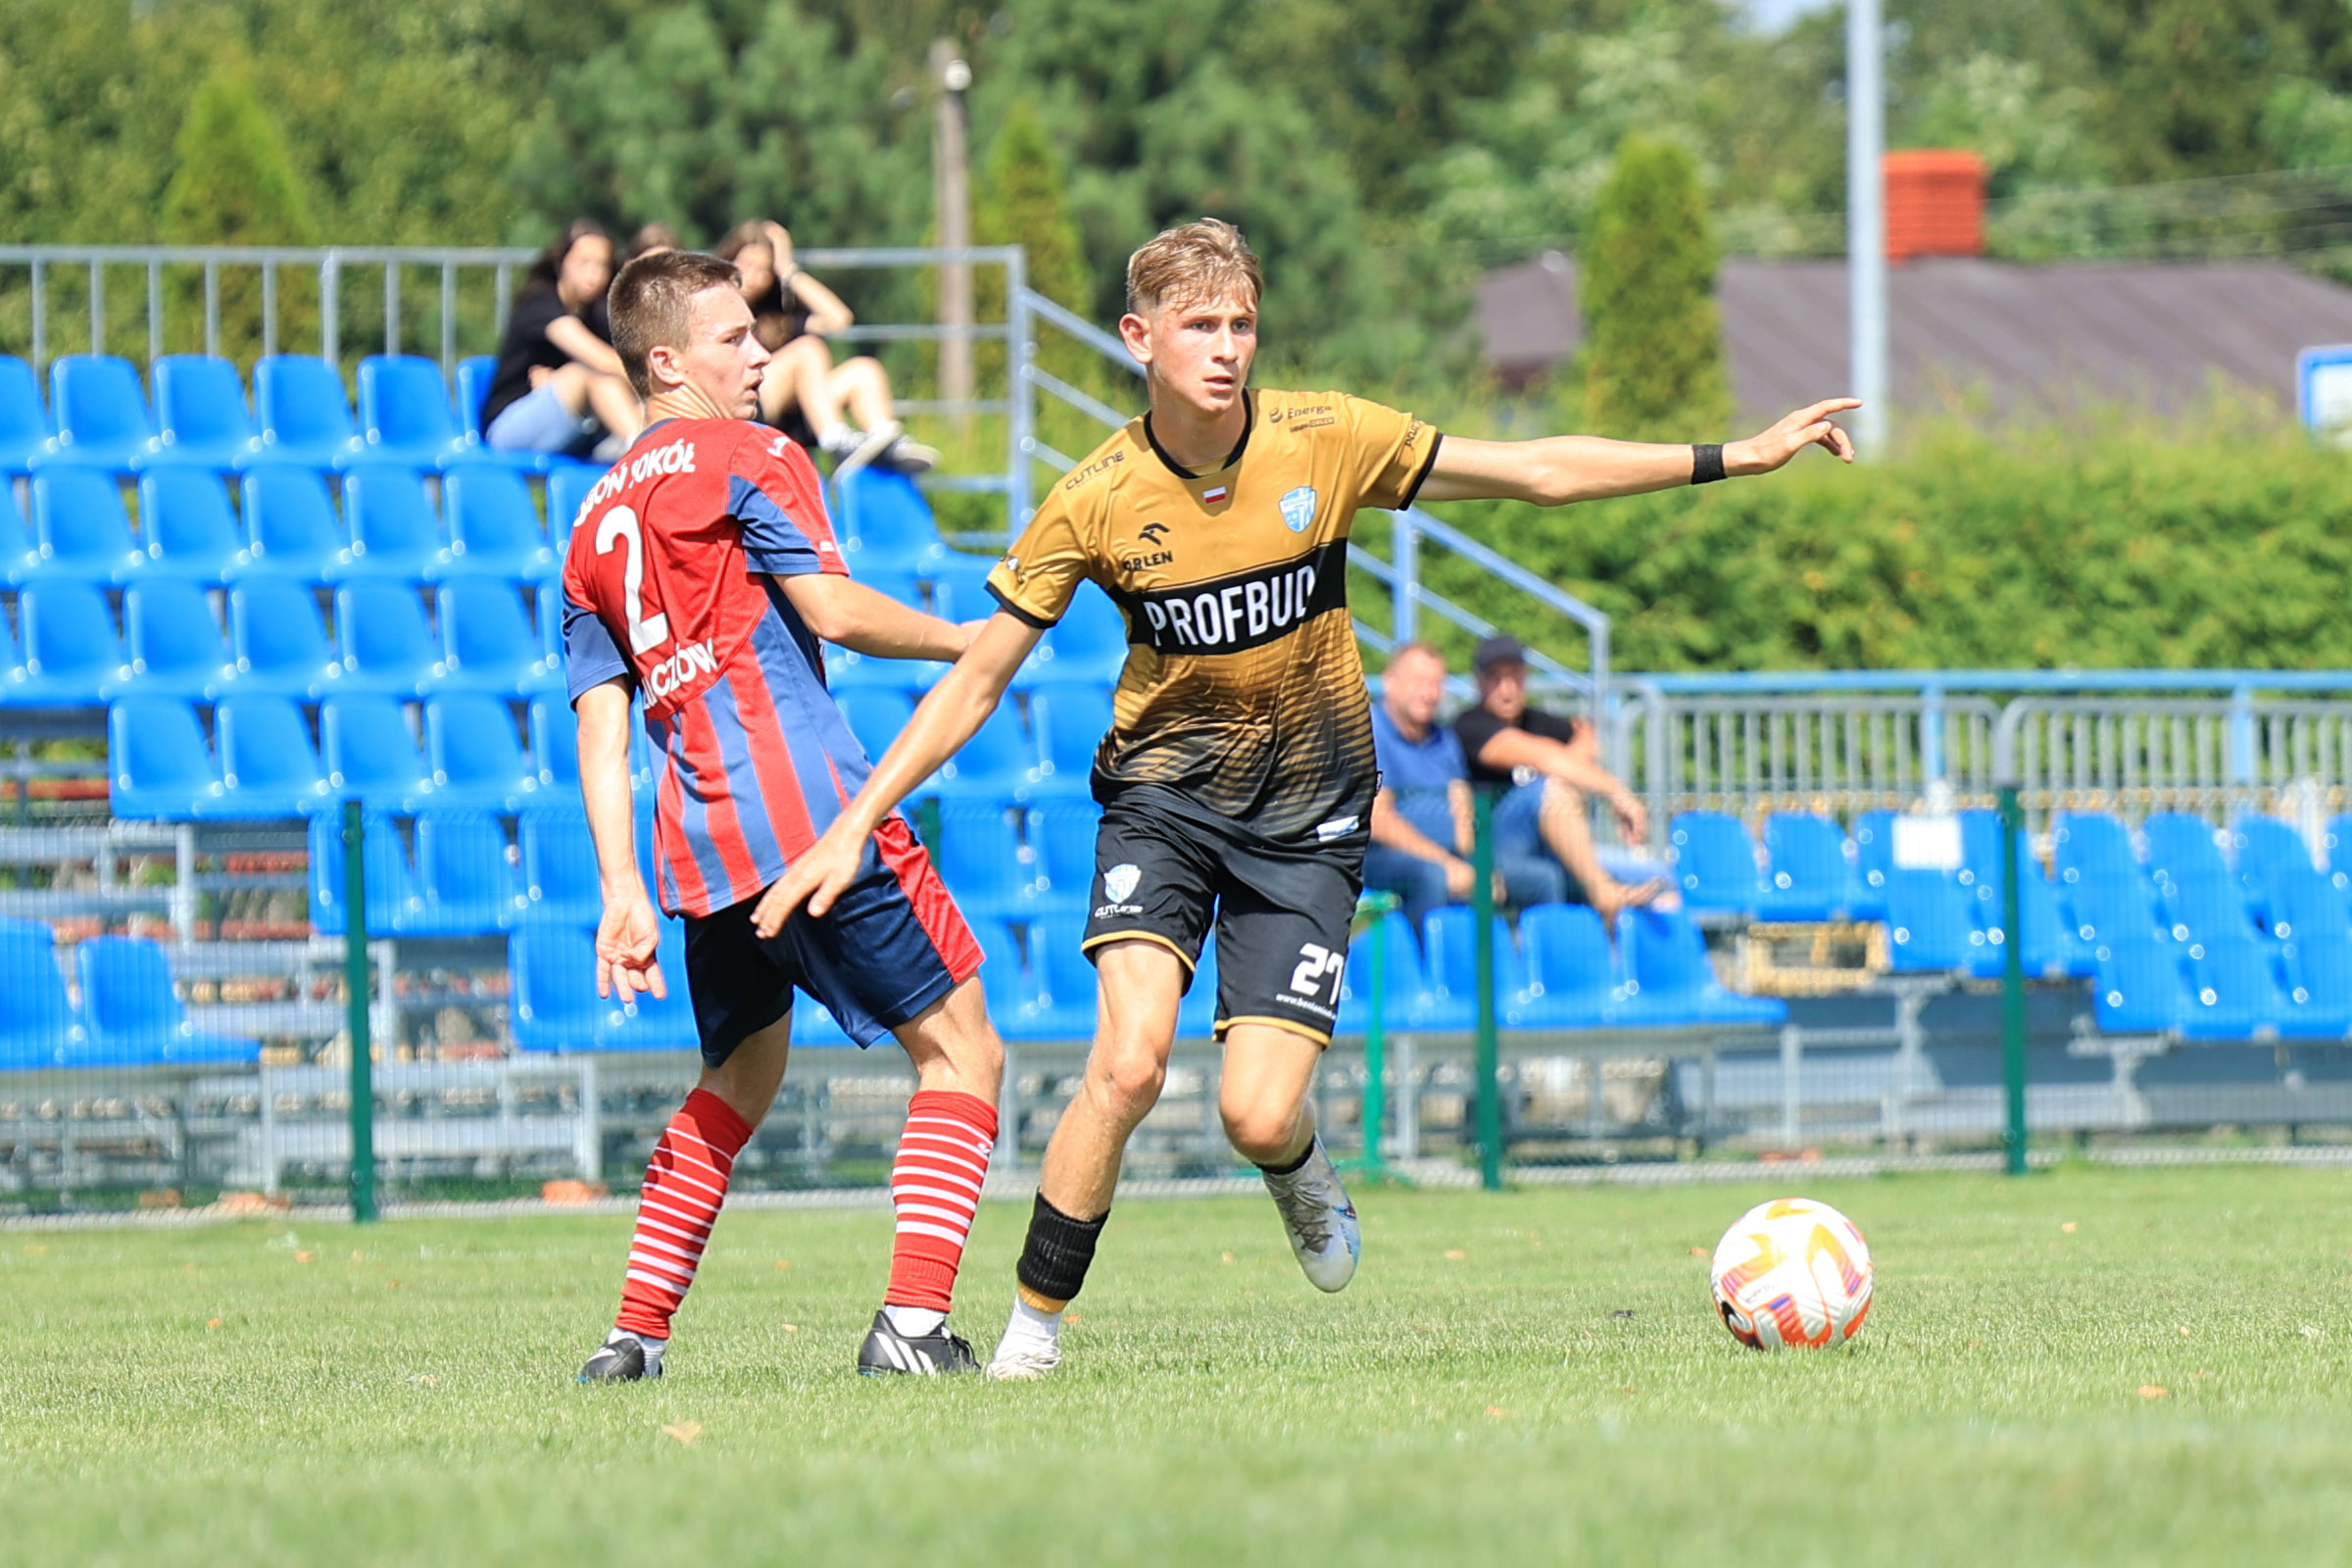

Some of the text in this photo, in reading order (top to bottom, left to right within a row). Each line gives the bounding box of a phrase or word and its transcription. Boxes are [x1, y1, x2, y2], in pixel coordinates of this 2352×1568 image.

[596, 504, 669, 656] 2
[1123, 551, 1173, 571] ORLEN
[1144, 564, 1316, 648] PROFBUD
